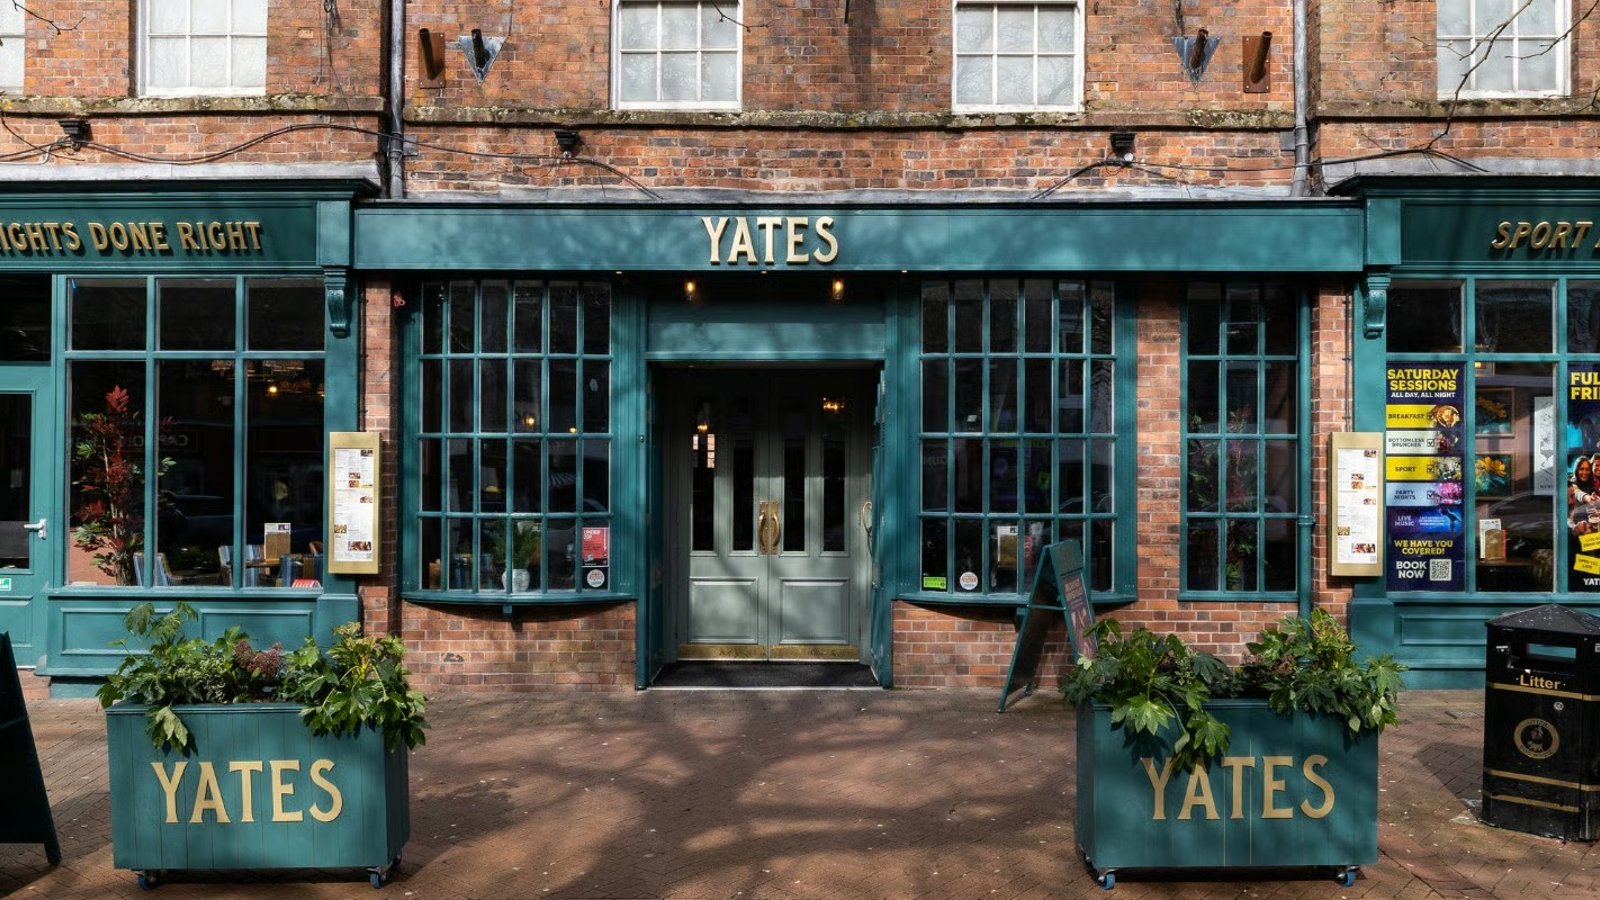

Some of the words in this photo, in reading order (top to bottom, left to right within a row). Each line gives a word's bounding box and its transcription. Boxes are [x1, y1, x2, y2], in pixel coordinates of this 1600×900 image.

[0, 222, 80, 250] IGHTS
[88, 222, 169, 250] DONE
[176, 221, 261, 250] RIGHT
[702, 216, 839, 263] YATES
[1491, 221, 1593, 249] SPORT
[1387, 368, 1459, 380] SATURDAY
[1390, 380, 1457, 391] SESSIONS
[1571, 387, 1600, 400] FRI
[1394, 540, 1409, 548] WE
[1410, 540, 1433, 548] HAVE
[1435, 540, 1453, 548] YOU
[1396, 561, 1427, 570] BOOK
[1398, 570, 1425, 578] NOW
[1583, 577, 1600, 586] YAT
[1520, 674, 1561, 690] Litter
[151, 759, 343, 823] YATES
[1141, 754, 1336, 820] YATES
